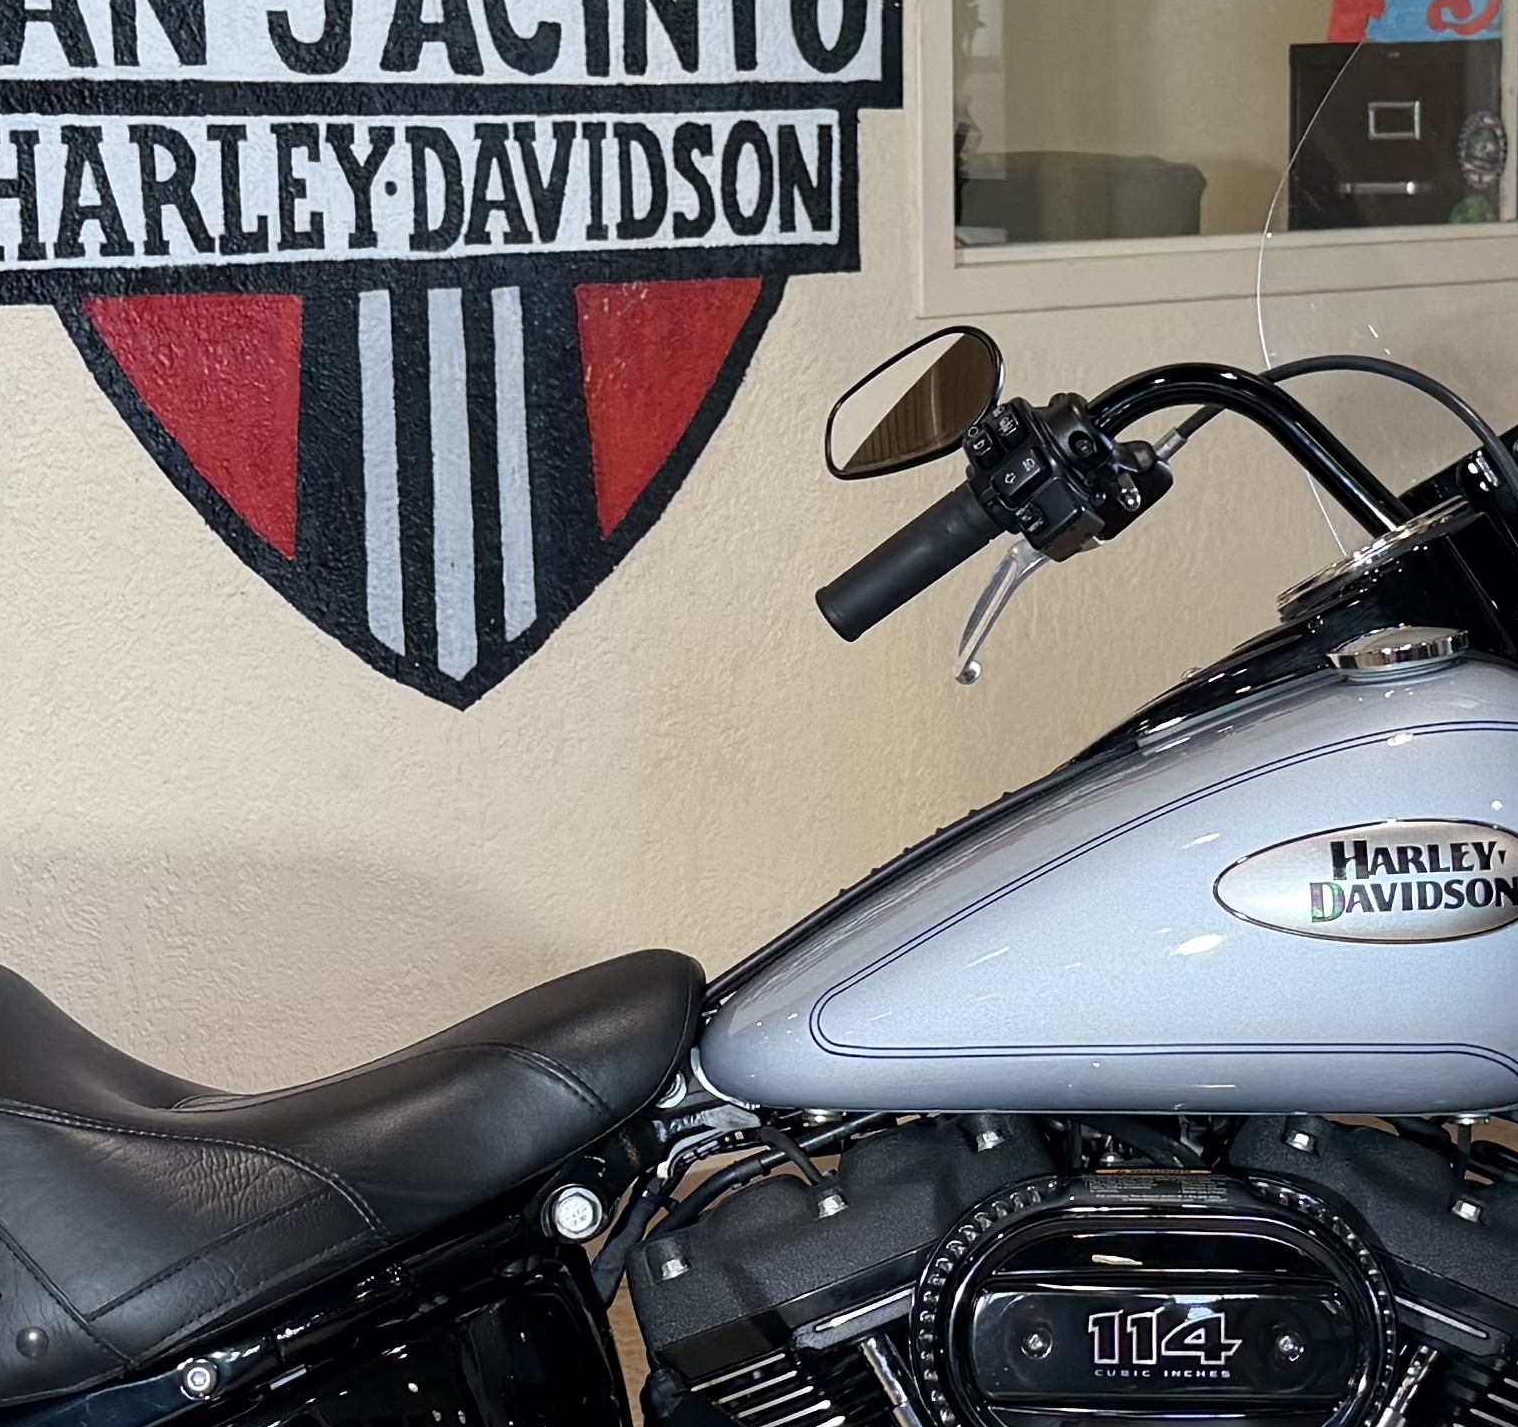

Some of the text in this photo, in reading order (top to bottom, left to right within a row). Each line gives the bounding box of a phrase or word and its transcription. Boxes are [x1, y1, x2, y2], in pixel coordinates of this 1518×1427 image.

[1088, 1307, 1243, 1365] 114
[1094, 1369, 1231, 1378] CUBIC INCHES
